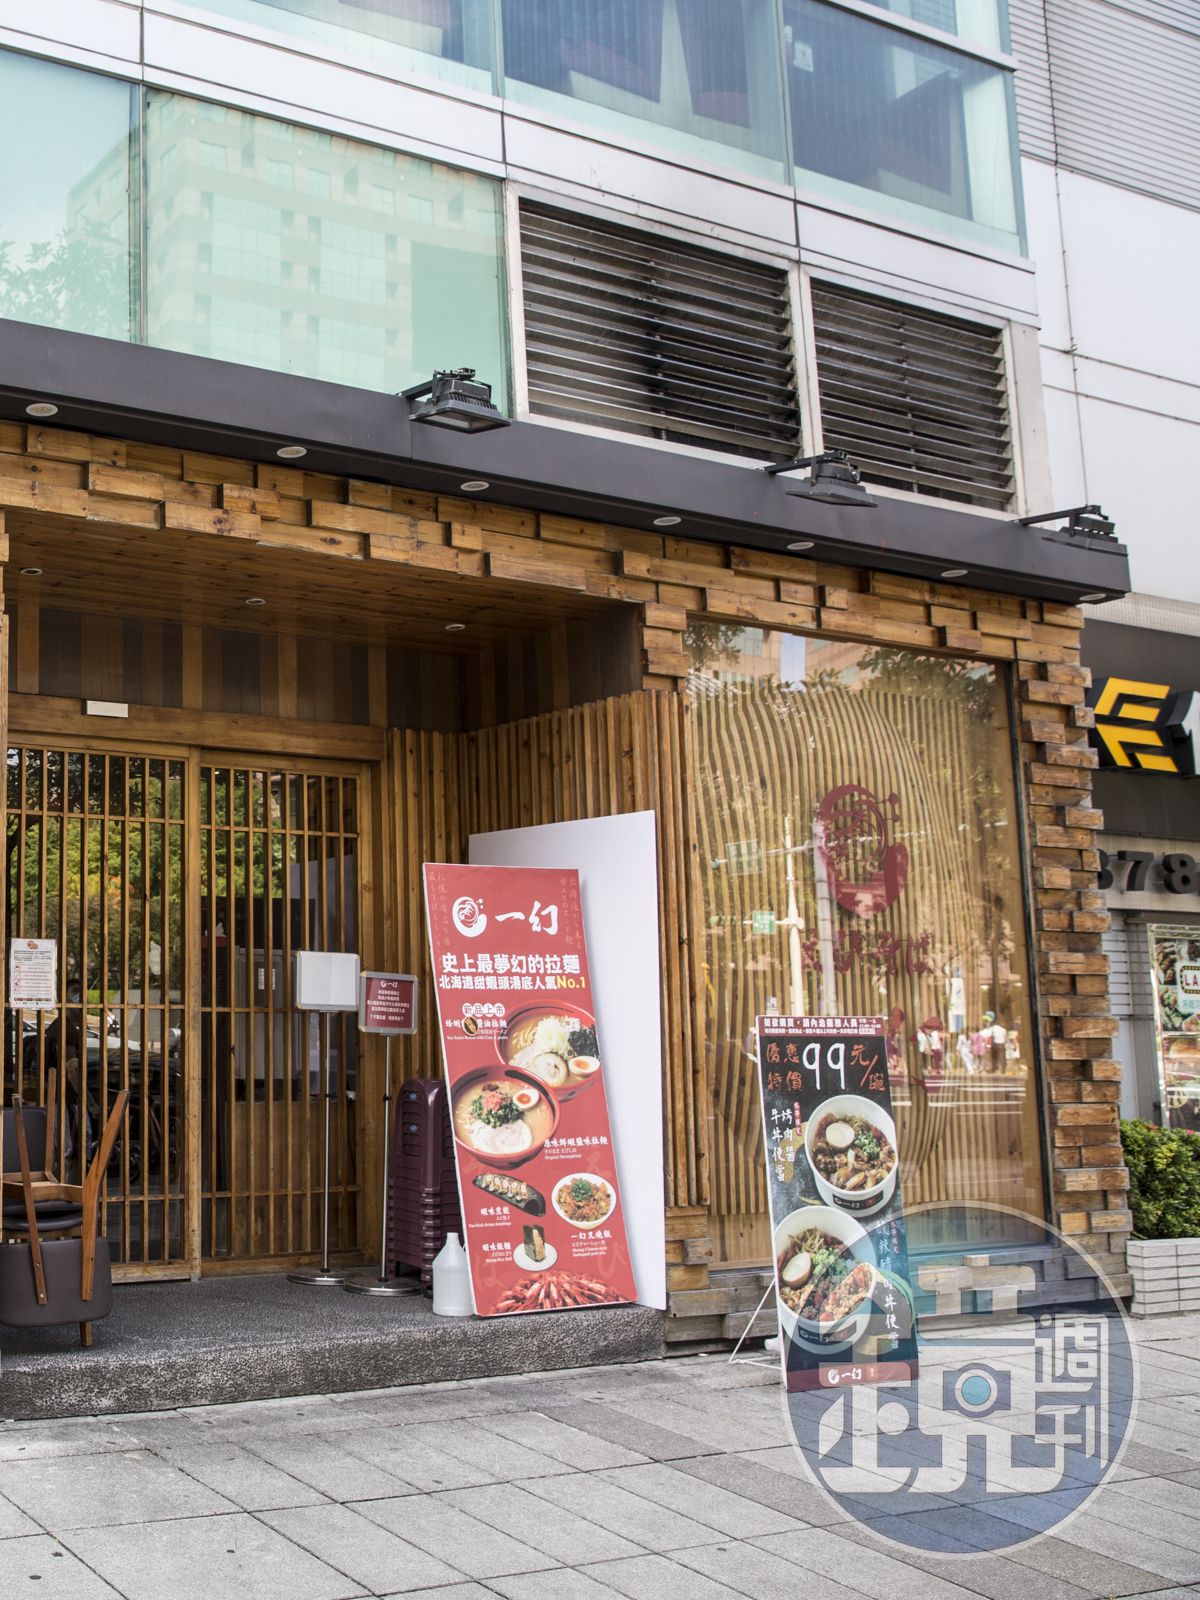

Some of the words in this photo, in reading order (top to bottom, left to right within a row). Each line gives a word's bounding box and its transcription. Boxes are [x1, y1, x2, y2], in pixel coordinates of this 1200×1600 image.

[494, 900, 558, 935] 一幻
[442, 953, 581, 974] 史上最夢幻的拉麵
[463, 1003, 505, 1017] 新品上市
[802, 1042, 846, 1090] 99
